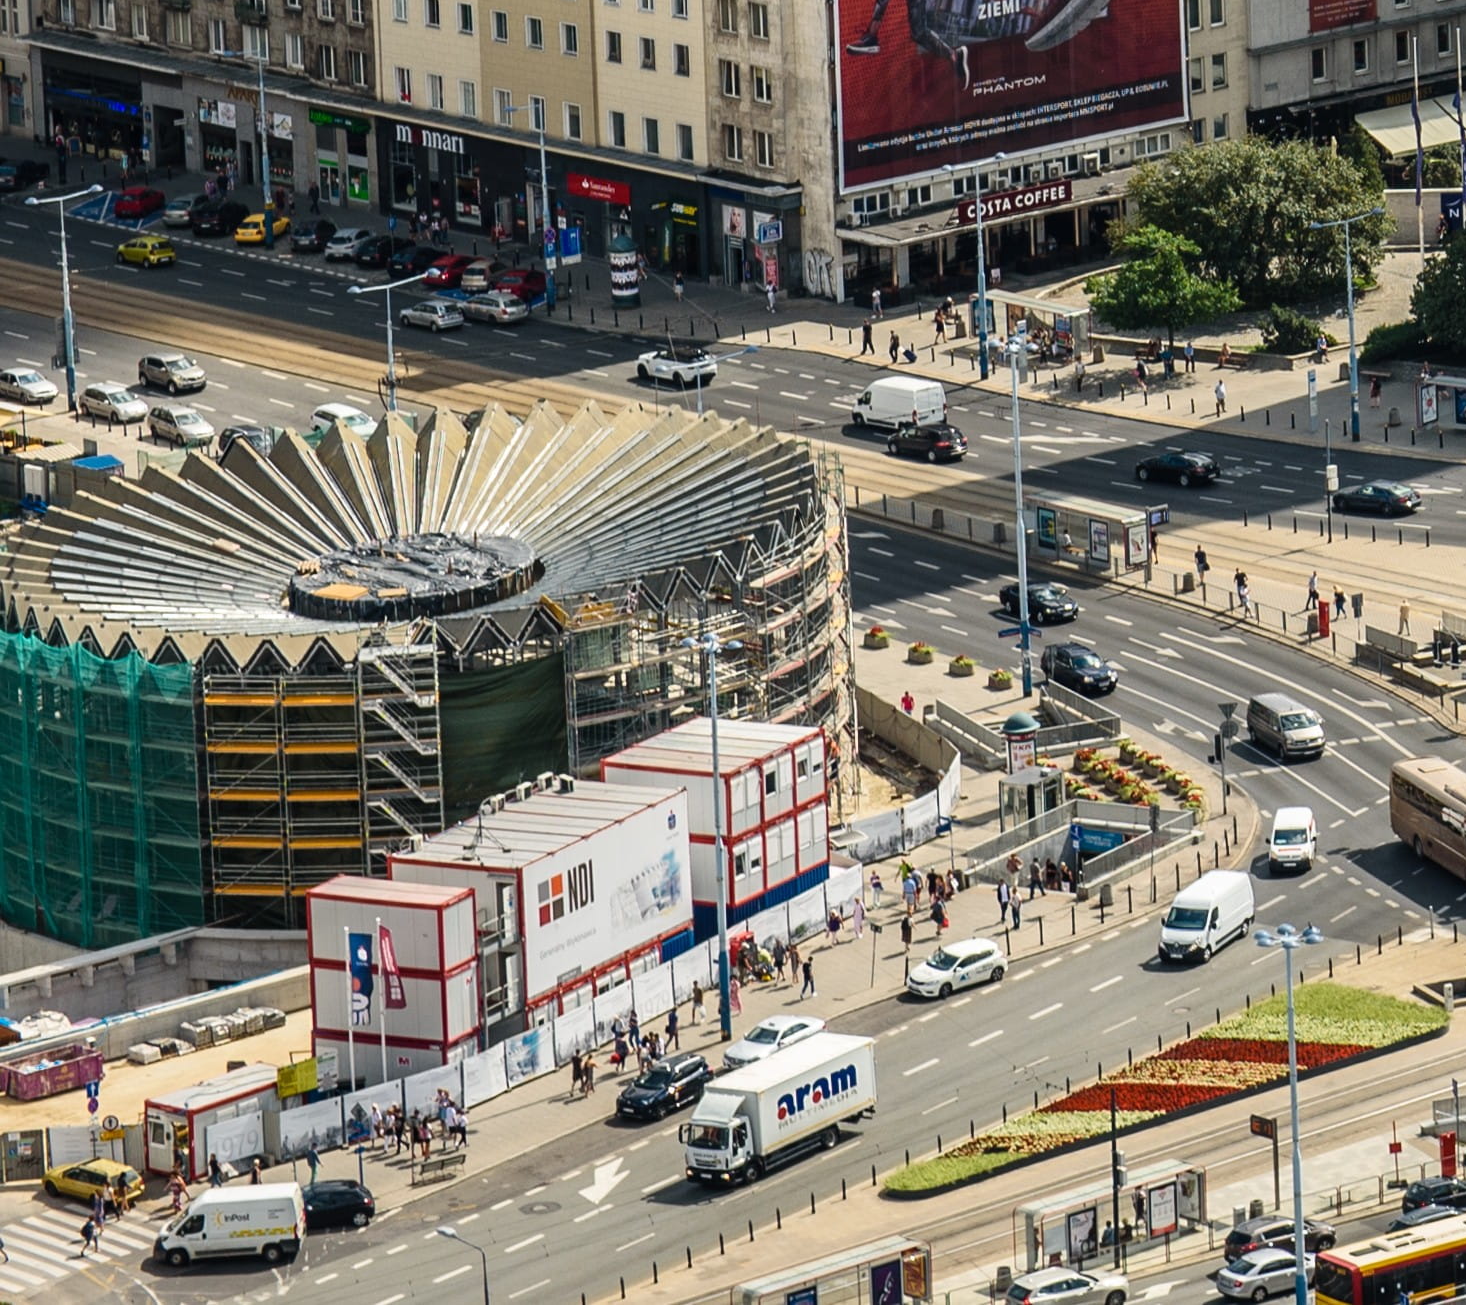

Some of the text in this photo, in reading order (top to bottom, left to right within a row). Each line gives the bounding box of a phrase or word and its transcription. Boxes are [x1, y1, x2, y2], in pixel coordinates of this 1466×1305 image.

[973, 74, 1047, 97] PHANTOM
[967, 186, 1066, 219] COSTA COFFEE
[567, 858, 595, 914] NDI
[777, 1064, 858, 1121] aram
[224, 1212, 250, 1222] InPost
